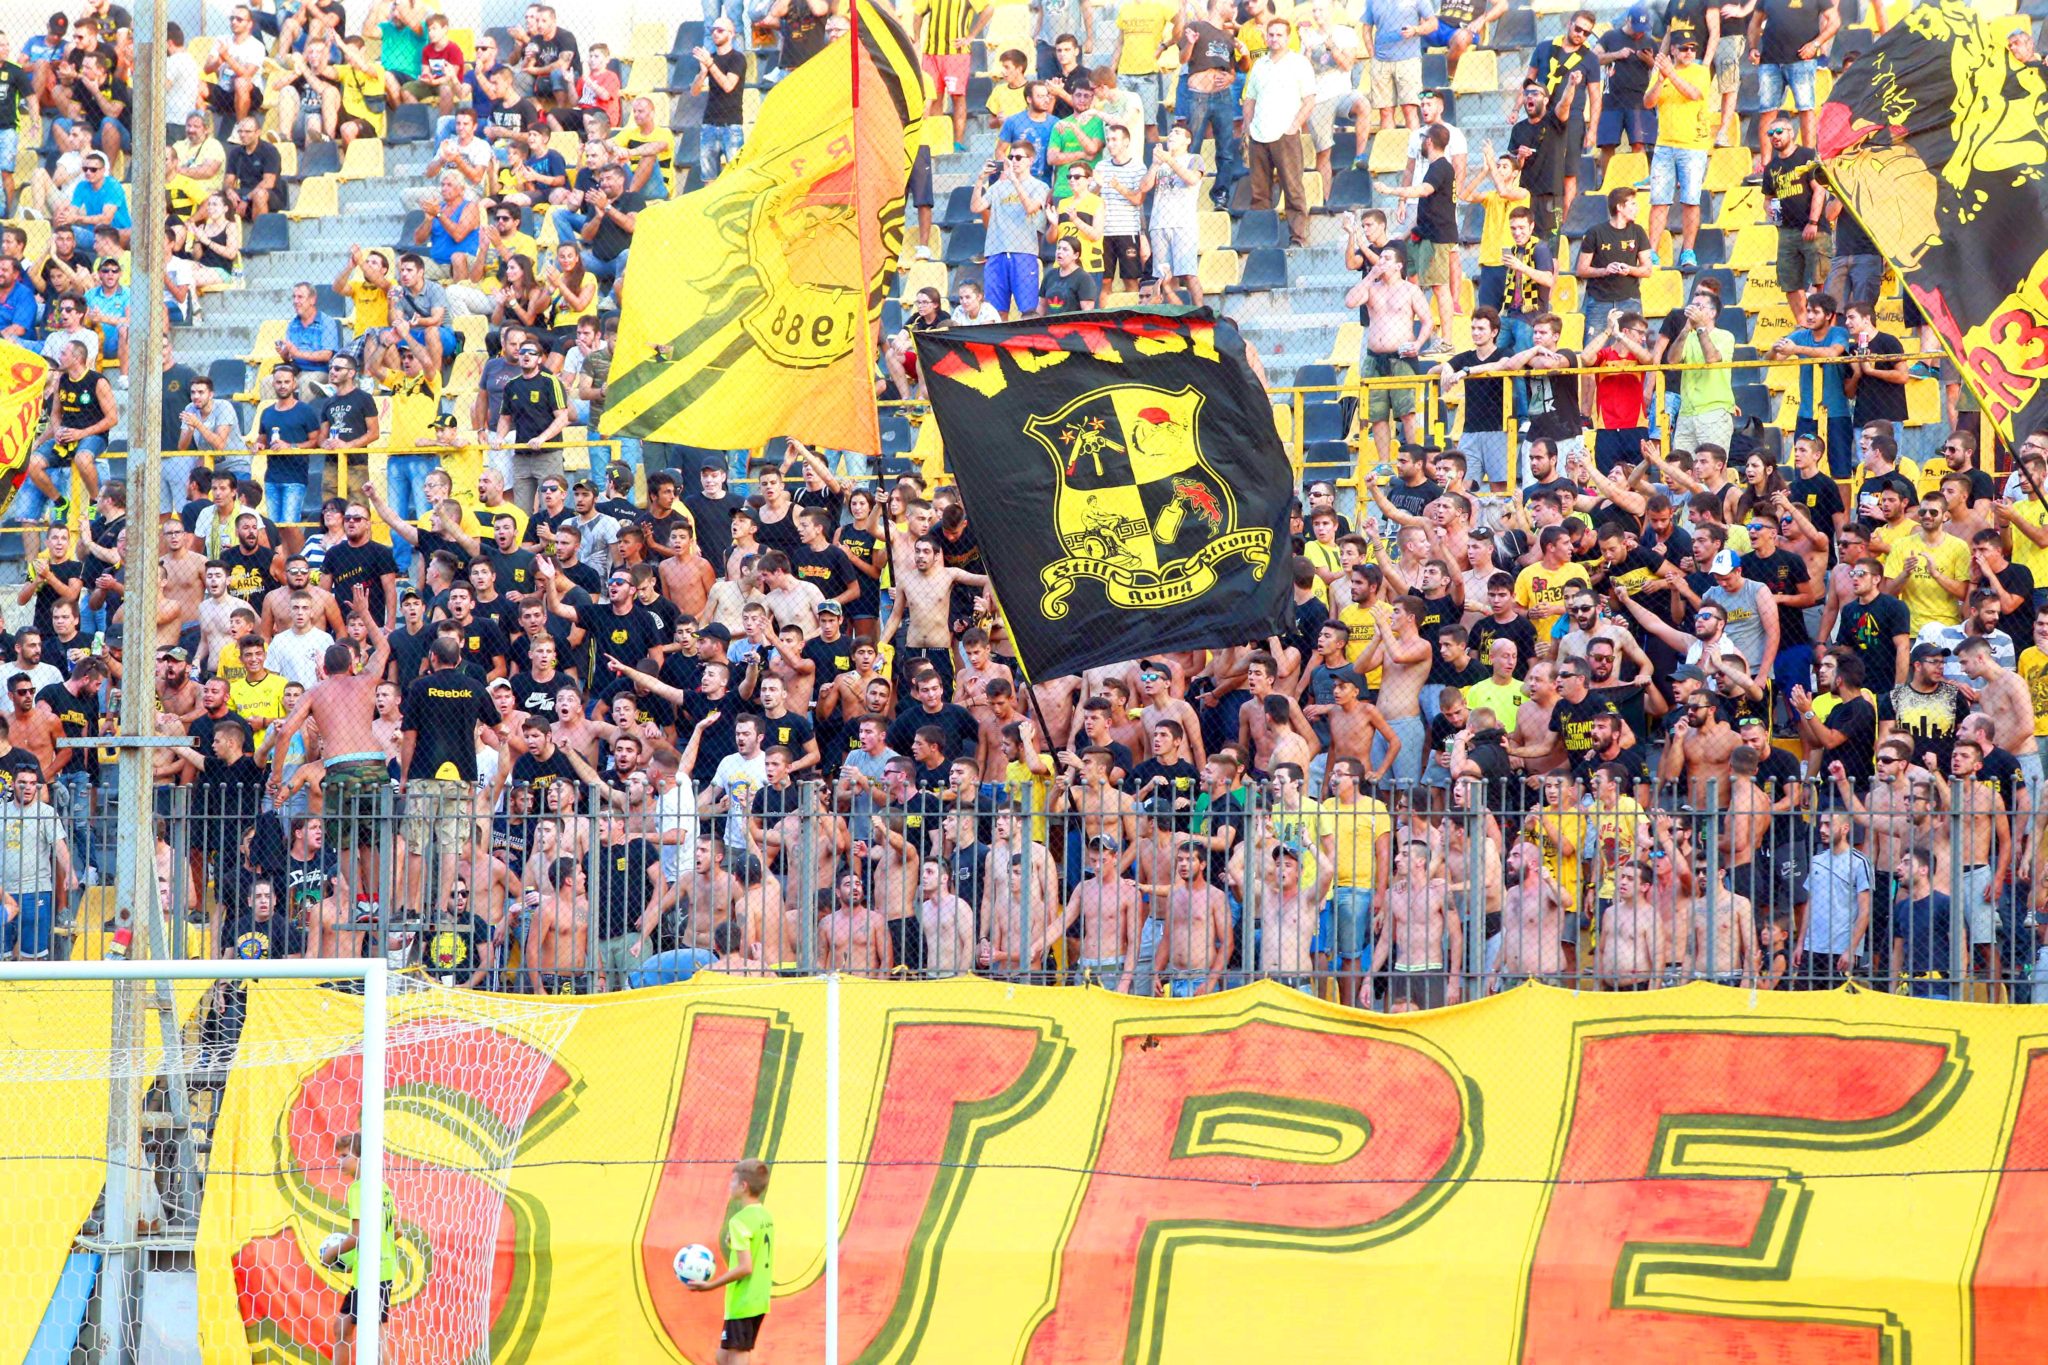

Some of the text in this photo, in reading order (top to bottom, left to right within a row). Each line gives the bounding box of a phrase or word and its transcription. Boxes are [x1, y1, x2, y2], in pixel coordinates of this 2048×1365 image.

[1064, 226, 1079, 237] 22
[1200, 530, 1268, 562] Strong
[1053, 561, 1109, 579] Still
[237, 577, 260, 588] ARIS
[1127, 579, 1194, 604] going
[428, 687, 473, 698] Reebok
[232, 1000, 2048, 1365] SUPE
